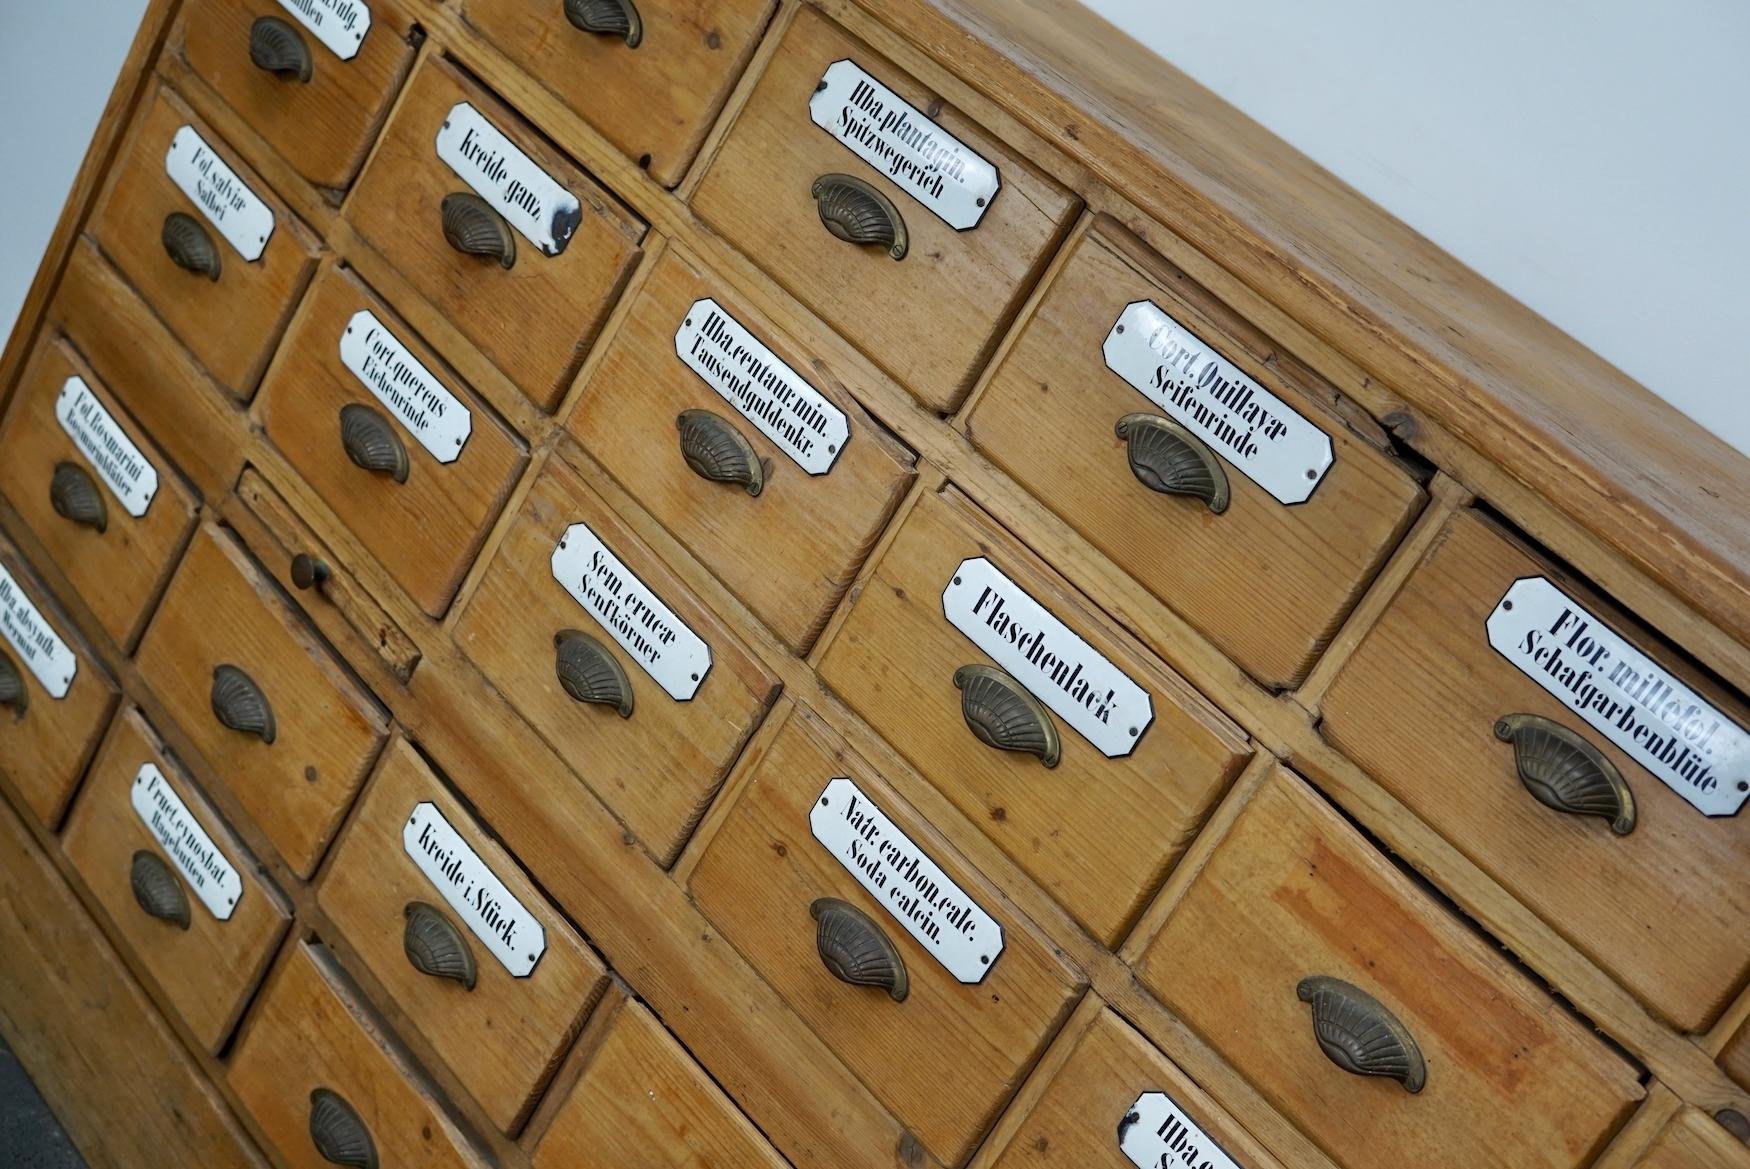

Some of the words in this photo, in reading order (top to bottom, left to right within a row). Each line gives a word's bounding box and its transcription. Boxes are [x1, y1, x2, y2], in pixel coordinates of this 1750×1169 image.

[459, 128, 507, 185] Kreide
[837, 106, 944, 200] Spitzwegerich
[196, 180, 228, 221] Salbei
[362, 355, 429, 430] Eichenrinde
[690, 333, 814, 458] Tausendguldenkr.
[1150, 365, 1258, 461] Seifenrinde
[578, 573, 662, 664] Senfkörner
[587, 550, 623, 600] Sem.
[972, 585, 1119, 726] Flaschenlack
[1518, 629, 1719, 795] Schafgarbenblüte
[152, 810, 206, 888] Hagebutten
[418, 822, 465, 887] Kreide
[846, 838, 887, 889] Soda
[890, 886, 941, 945] calcin.
